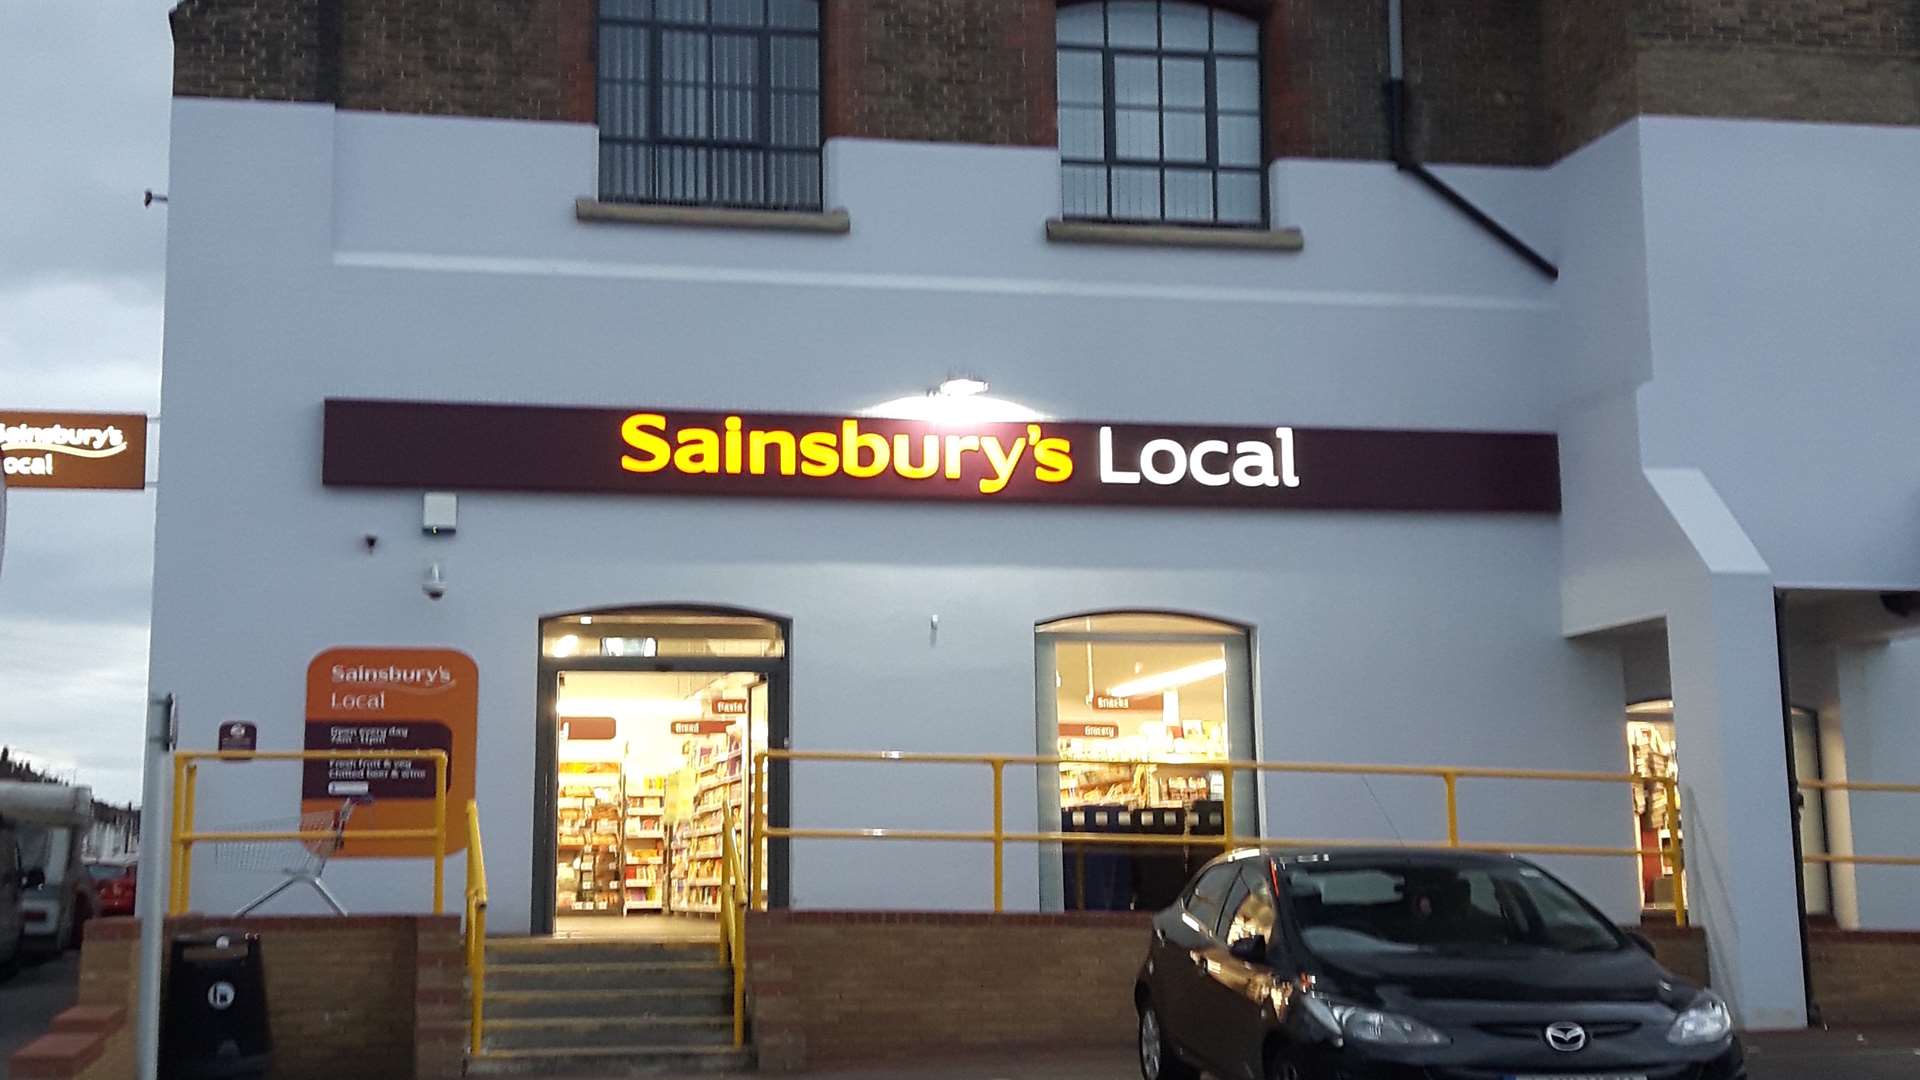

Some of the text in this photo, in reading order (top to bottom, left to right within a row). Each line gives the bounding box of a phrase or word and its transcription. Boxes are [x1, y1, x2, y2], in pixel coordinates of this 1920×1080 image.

[3, 453, 53, 475] ocal
[621, 413, 1300, 494] Sainsbury's Local
[331, 664, 451, 686] Sainsbury's
[331, 691, 385, 710] Local
